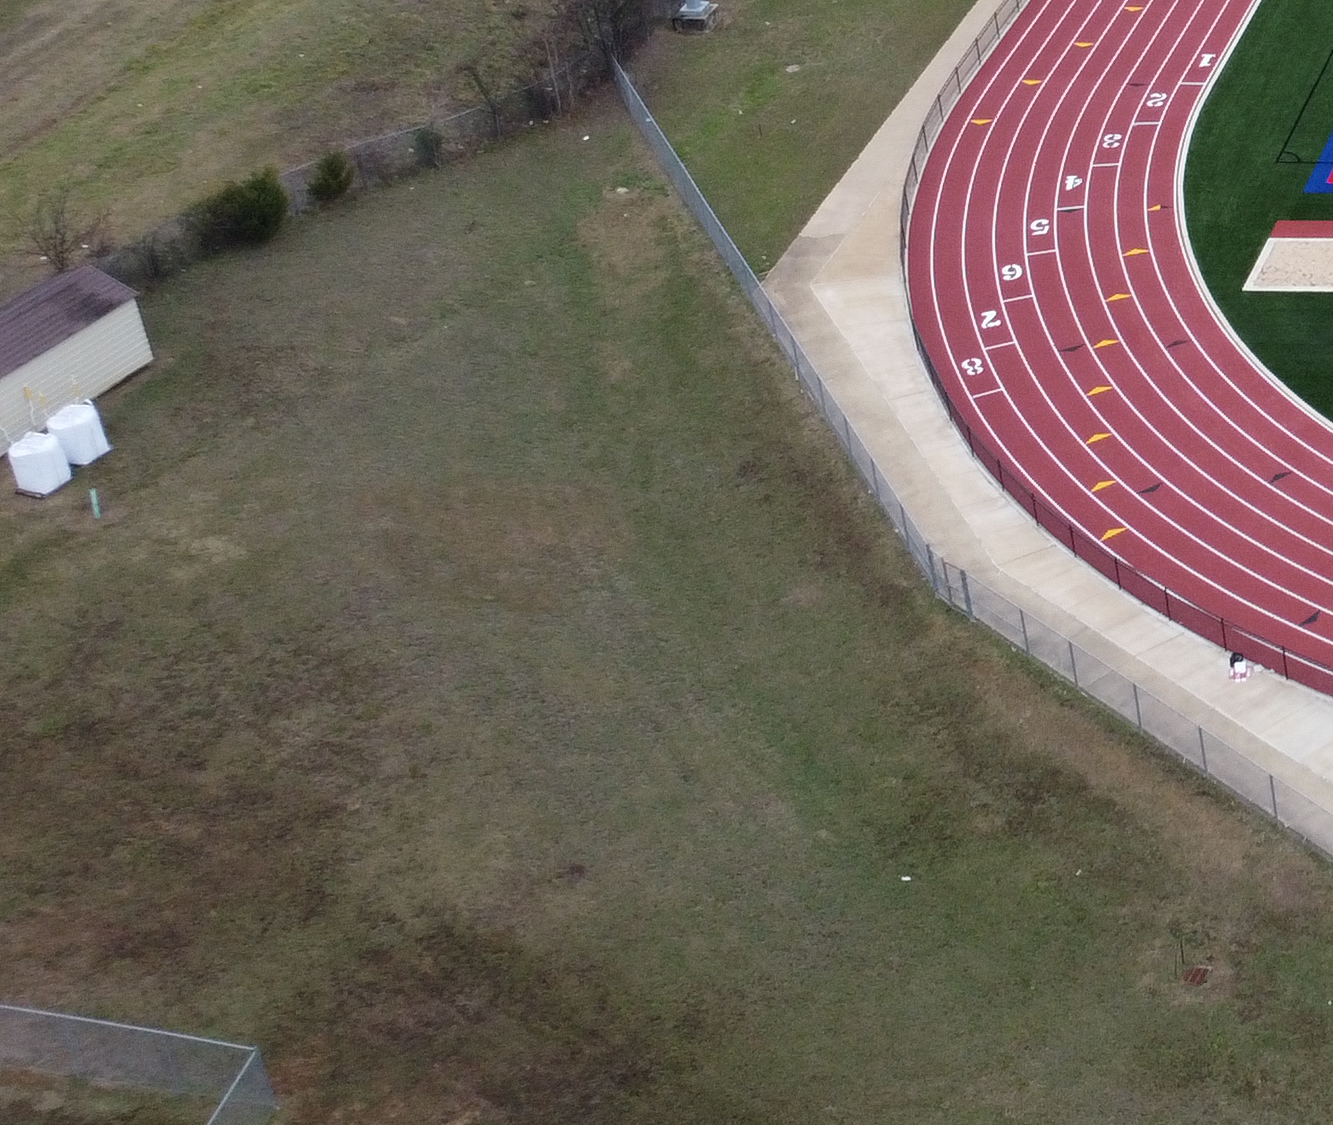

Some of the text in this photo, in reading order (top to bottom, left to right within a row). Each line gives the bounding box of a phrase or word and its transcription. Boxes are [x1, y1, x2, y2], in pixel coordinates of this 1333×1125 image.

[1199, 53, 1216, 68] 1
[1147, 92, 1167, 107] 2
[1103, 133, 1122, 149] 3
[1065, 175, 1083, 191] 4
[1030, 218, 1050, 236] 5
[1002, 263, 1022, 281] 6
[981, 310, 1001, 329] 7
[961, 358, 984, 376] 8
